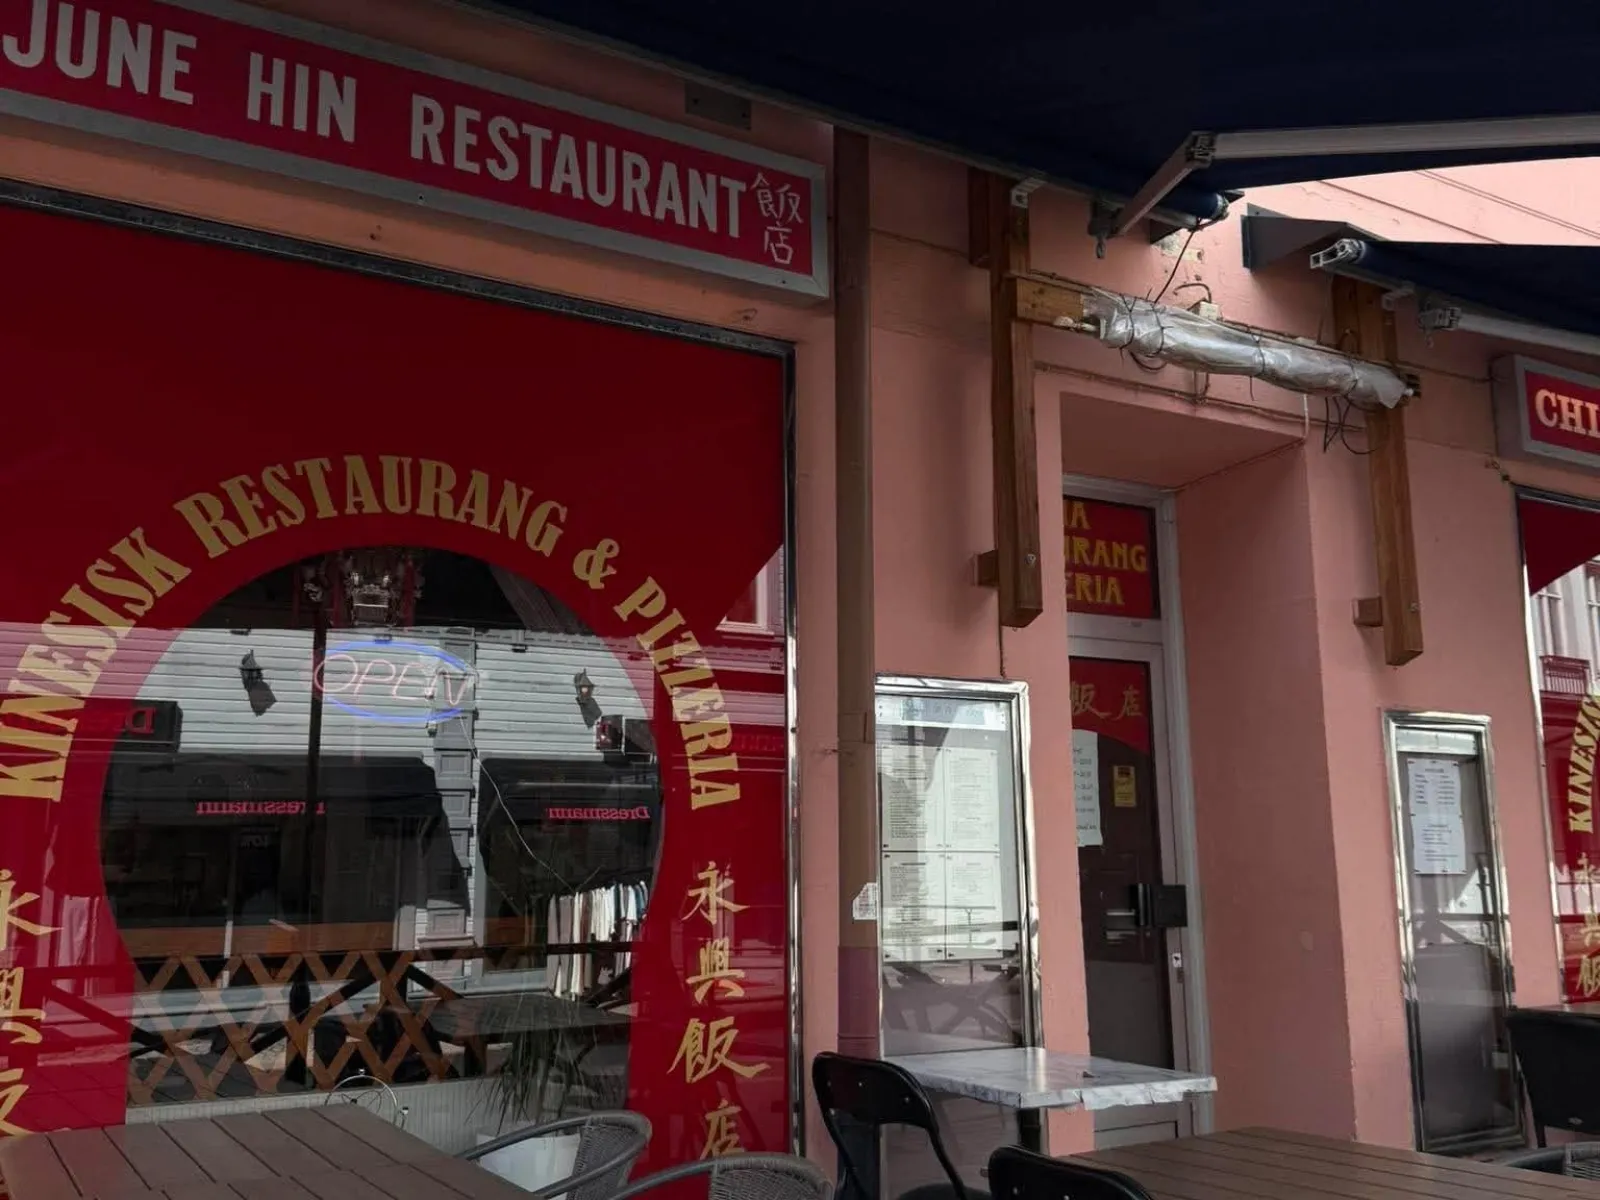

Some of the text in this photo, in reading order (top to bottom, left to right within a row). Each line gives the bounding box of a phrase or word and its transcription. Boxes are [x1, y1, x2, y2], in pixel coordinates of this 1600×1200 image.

[2, 0, 747, 239] JUNE HIN RESTAURANT
[749, 171, 804, 265] 飯店
[1534, 388, 1600, 440] CHI
[0, 526, 192, 802] KINESISK
[173, 454, 568, 559] RESTAURANG
[572, 538, 620, 590] &
[613, 575, 741, 811] PIZZERIA
[314, 653, 467, 706] OPEN
